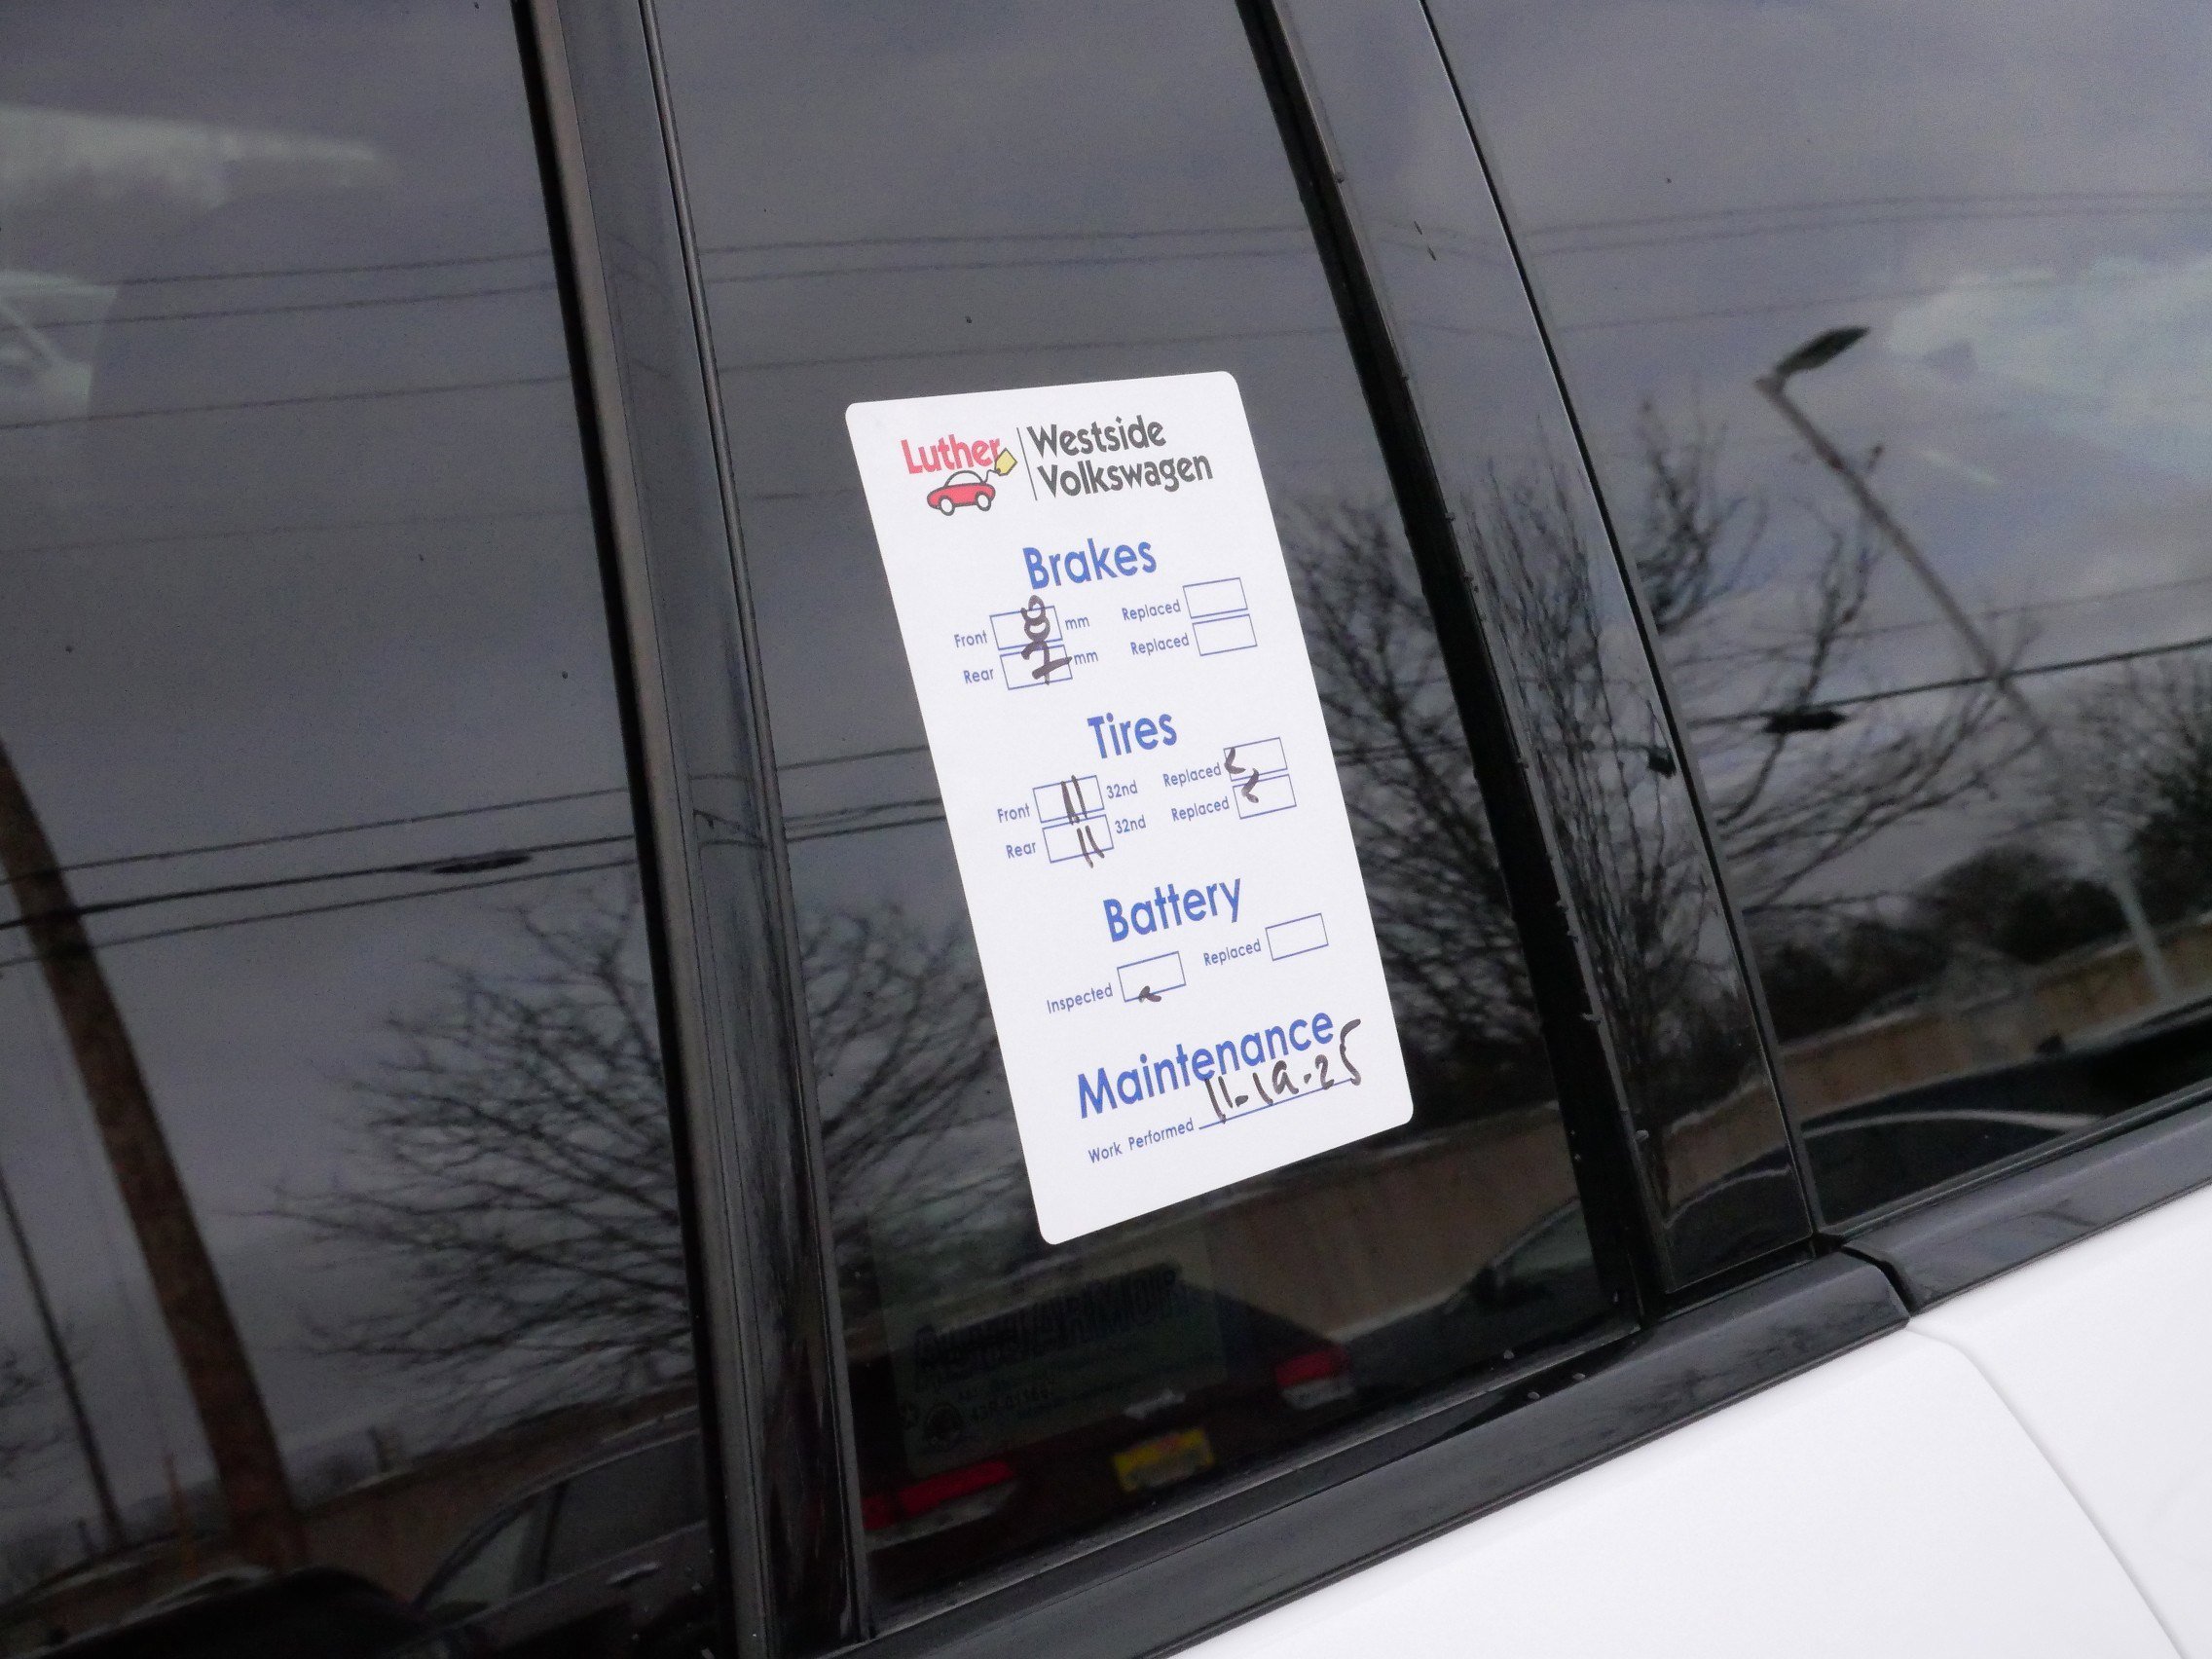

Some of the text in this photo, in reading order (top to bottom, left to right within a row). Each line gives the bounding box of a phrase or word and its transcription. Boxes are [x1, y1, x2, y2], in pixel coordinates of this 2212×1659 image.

[1026, 415, 1166, 458] Westside
[901, 434, 1001, 474] Luther
[1037, 455, 1213, 498] Volkswagen
[1023, 538, 1157, 590] Brakes
[1064, 615, 1090, 631] mm
[1122, 600, 1181, 622] Replaced
[953, 629, 988, 648] Front
[1130, 633, 1190, 656] Replaced
[1073, 650, 1099, 666] mm
[963, 668, 994, 684] Rear
[1087, 712, 1178, 759] Tires
[1162, 762, 1222, 788] Replaced
[1060, 774, 1088, 826] 11
[1106, 780, 1138, 799] 32nd
[997, 803, 1030, 824] Front
[1170, 795, 1230, 822] Replaced
[1115, 814, 1147, 834] 32nd
[1006, 841, 1036, 859] Rear
[1076, 825, 1105, 868] 11
[1103, 878, 1241, 943] Battery
[1203, 939, 1262, 967] Replaced
[1047, 983, 1114, 1014] Inspected
[1078, 1013, 1334, 1119] Maintenance
[1088, 1118, 1195, 1163] Work Performed
